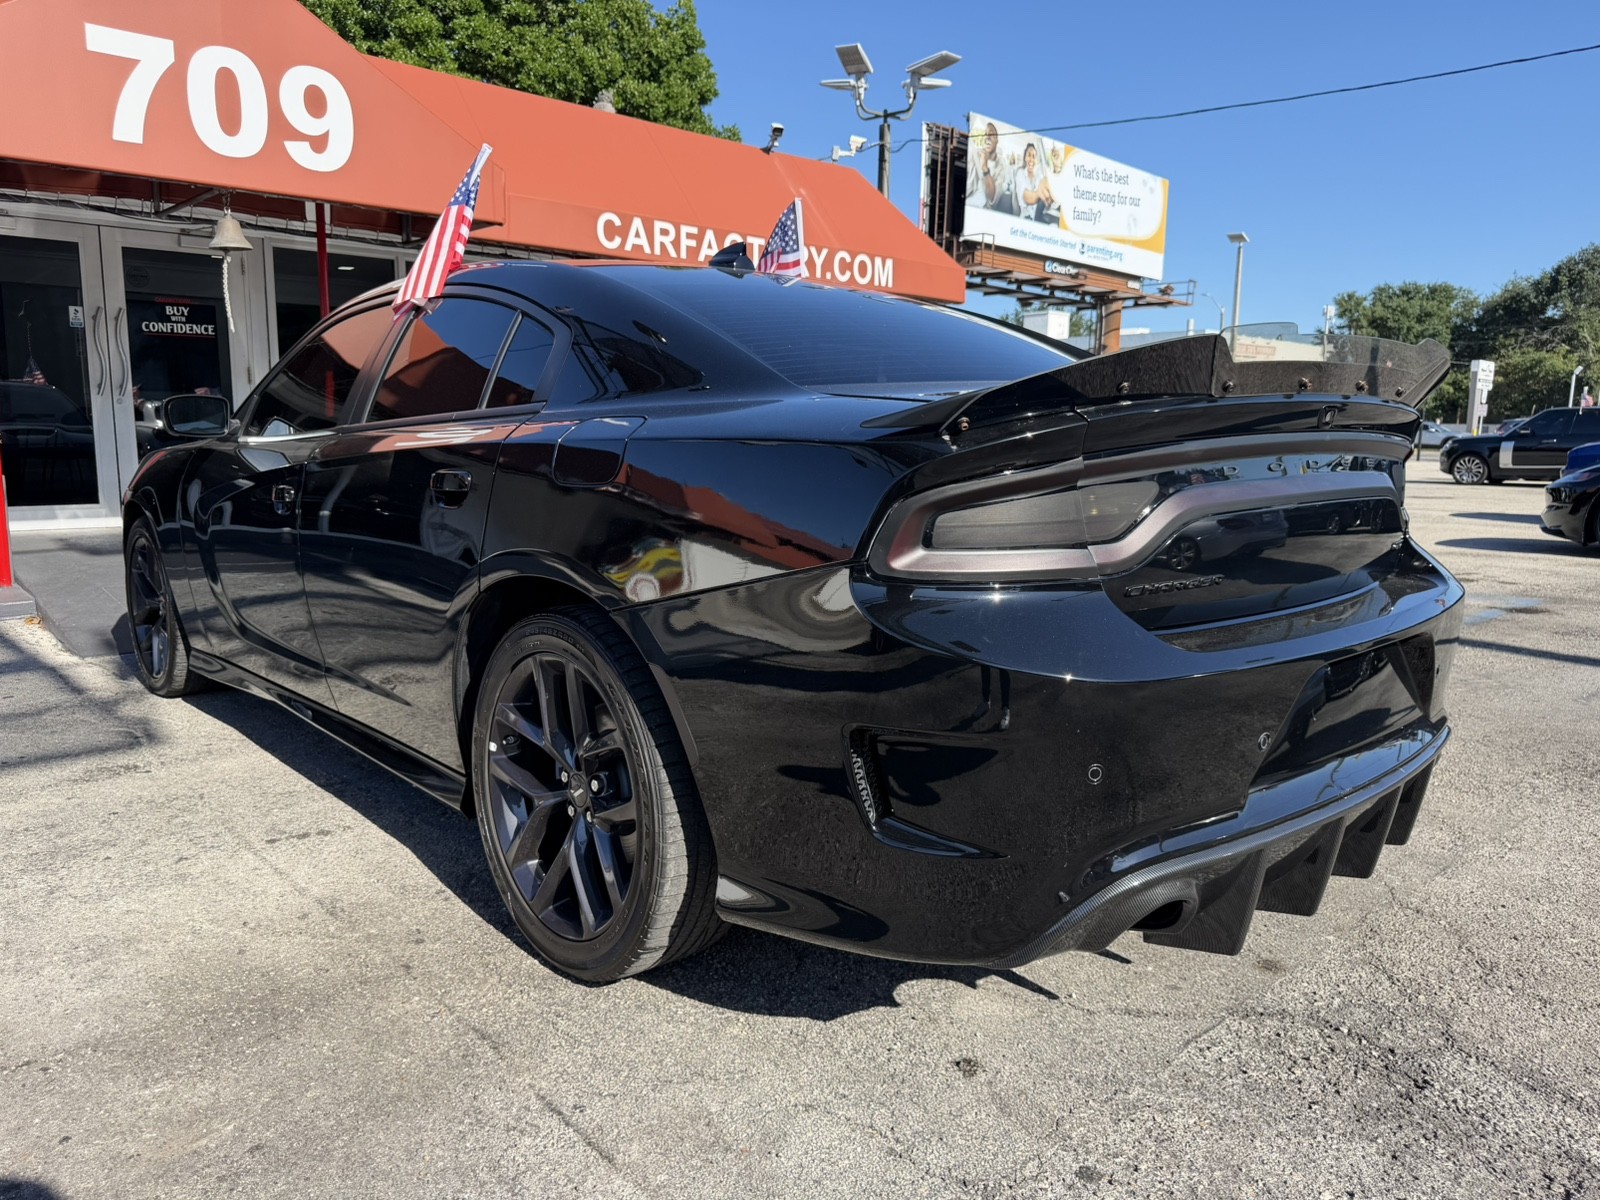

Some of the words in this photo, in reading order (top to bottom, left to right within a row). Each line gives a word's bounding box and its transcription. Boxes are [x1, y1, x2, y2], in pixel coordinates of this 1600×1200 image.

[84, 22, 354, 172] 709
[1073, 164, 1100, 181] What's
[1101, 168, 1113, 183] the
[1114, 170, 1129, 186] best
[1073, 185, 1097, 201] theme
[1098, 192, 1116, 207] song
[1117, 191, 1128, 205] for
[1128, 197, 1141, 207] our
[1072, 206, 1102, 226] family?
[596, 211, 894, 288] CARFATY.COM
[165, 305, 190, 316] BUY
[141, 321, 216, 335] CONFIDENCE
[1124, 574, 1225, 598] CHARGER
